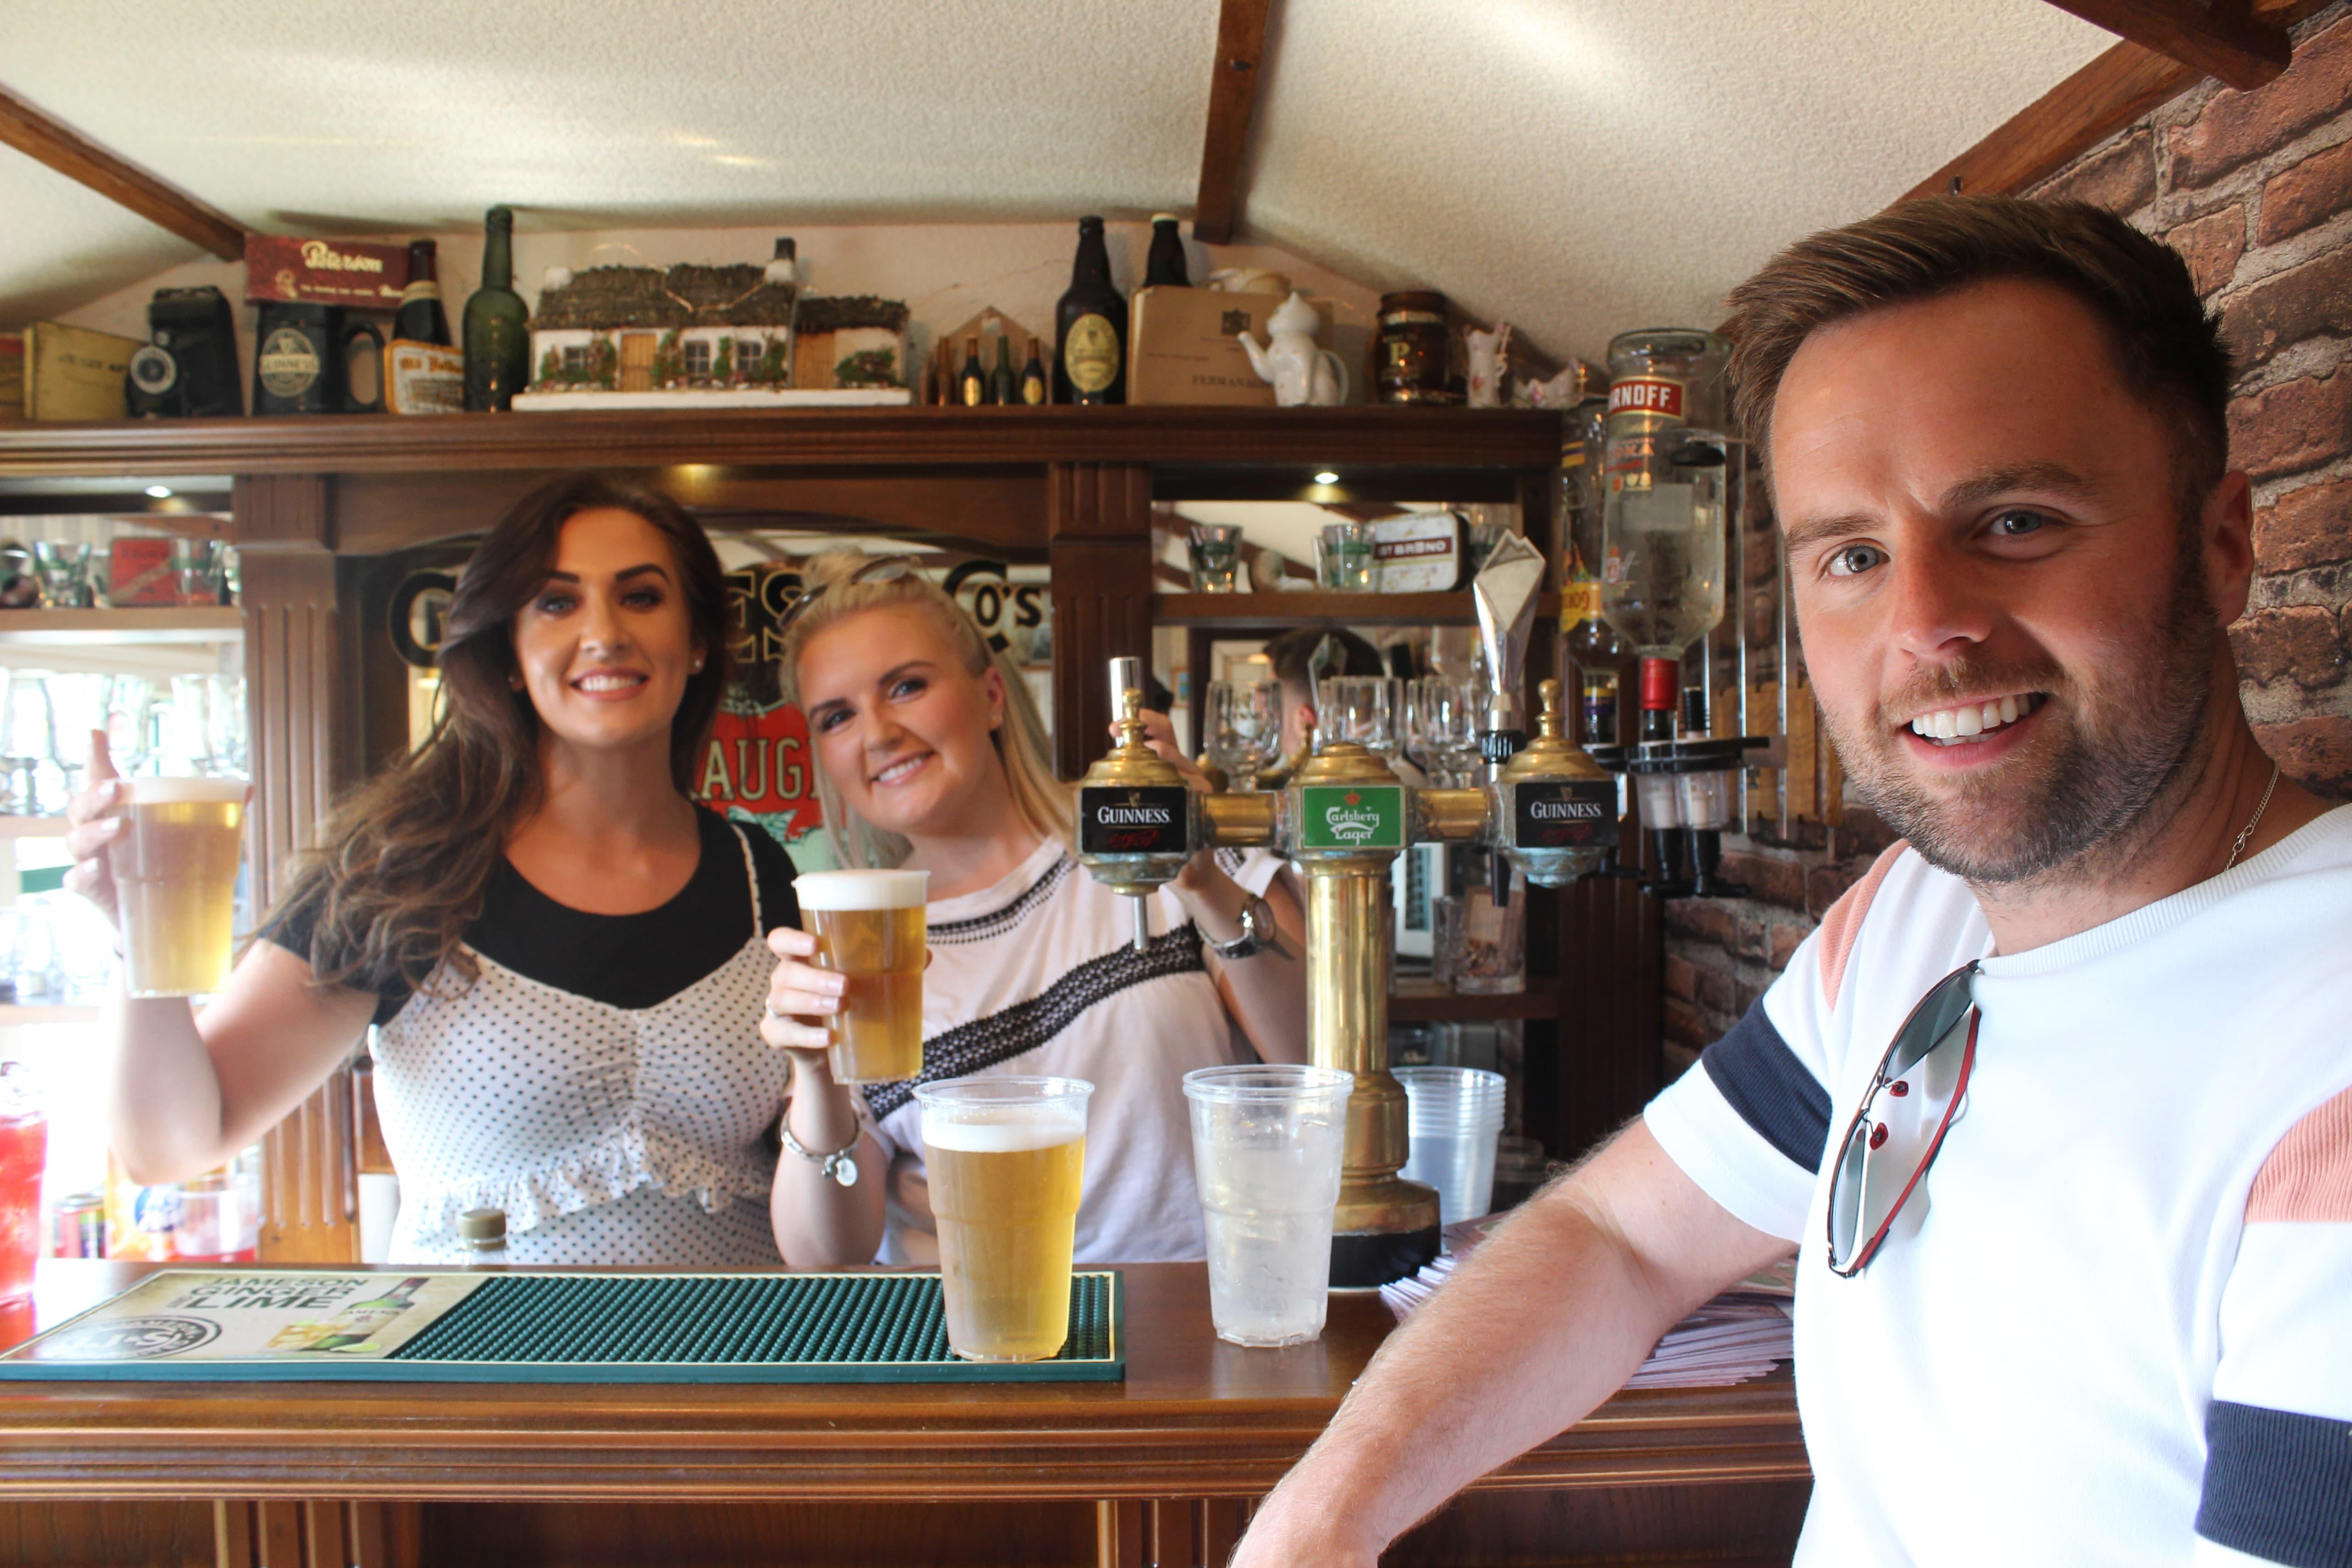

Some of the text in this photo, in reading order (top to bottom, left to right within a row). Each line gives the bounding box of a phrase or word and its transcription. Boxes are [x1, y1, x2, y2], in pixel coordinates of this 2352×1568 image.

[301, 240, 383, 273] Peterson
[1609, 384, 1671, 411] RNOFF
[689, 736, 822, 801] AUG
[1097, 806, 1170, 824] GUINNESS
[1325, 806, 1380, 828] Carlsberg
[1530, 801, 1603, 819] GUINNESS
[1335, 830, 1374, 846] Lager
[190, 1286, 356, 1296] GINGER
[205, 1277, 370, 1287] JAMESON
[184, 1296, 344, 1309] LIME
